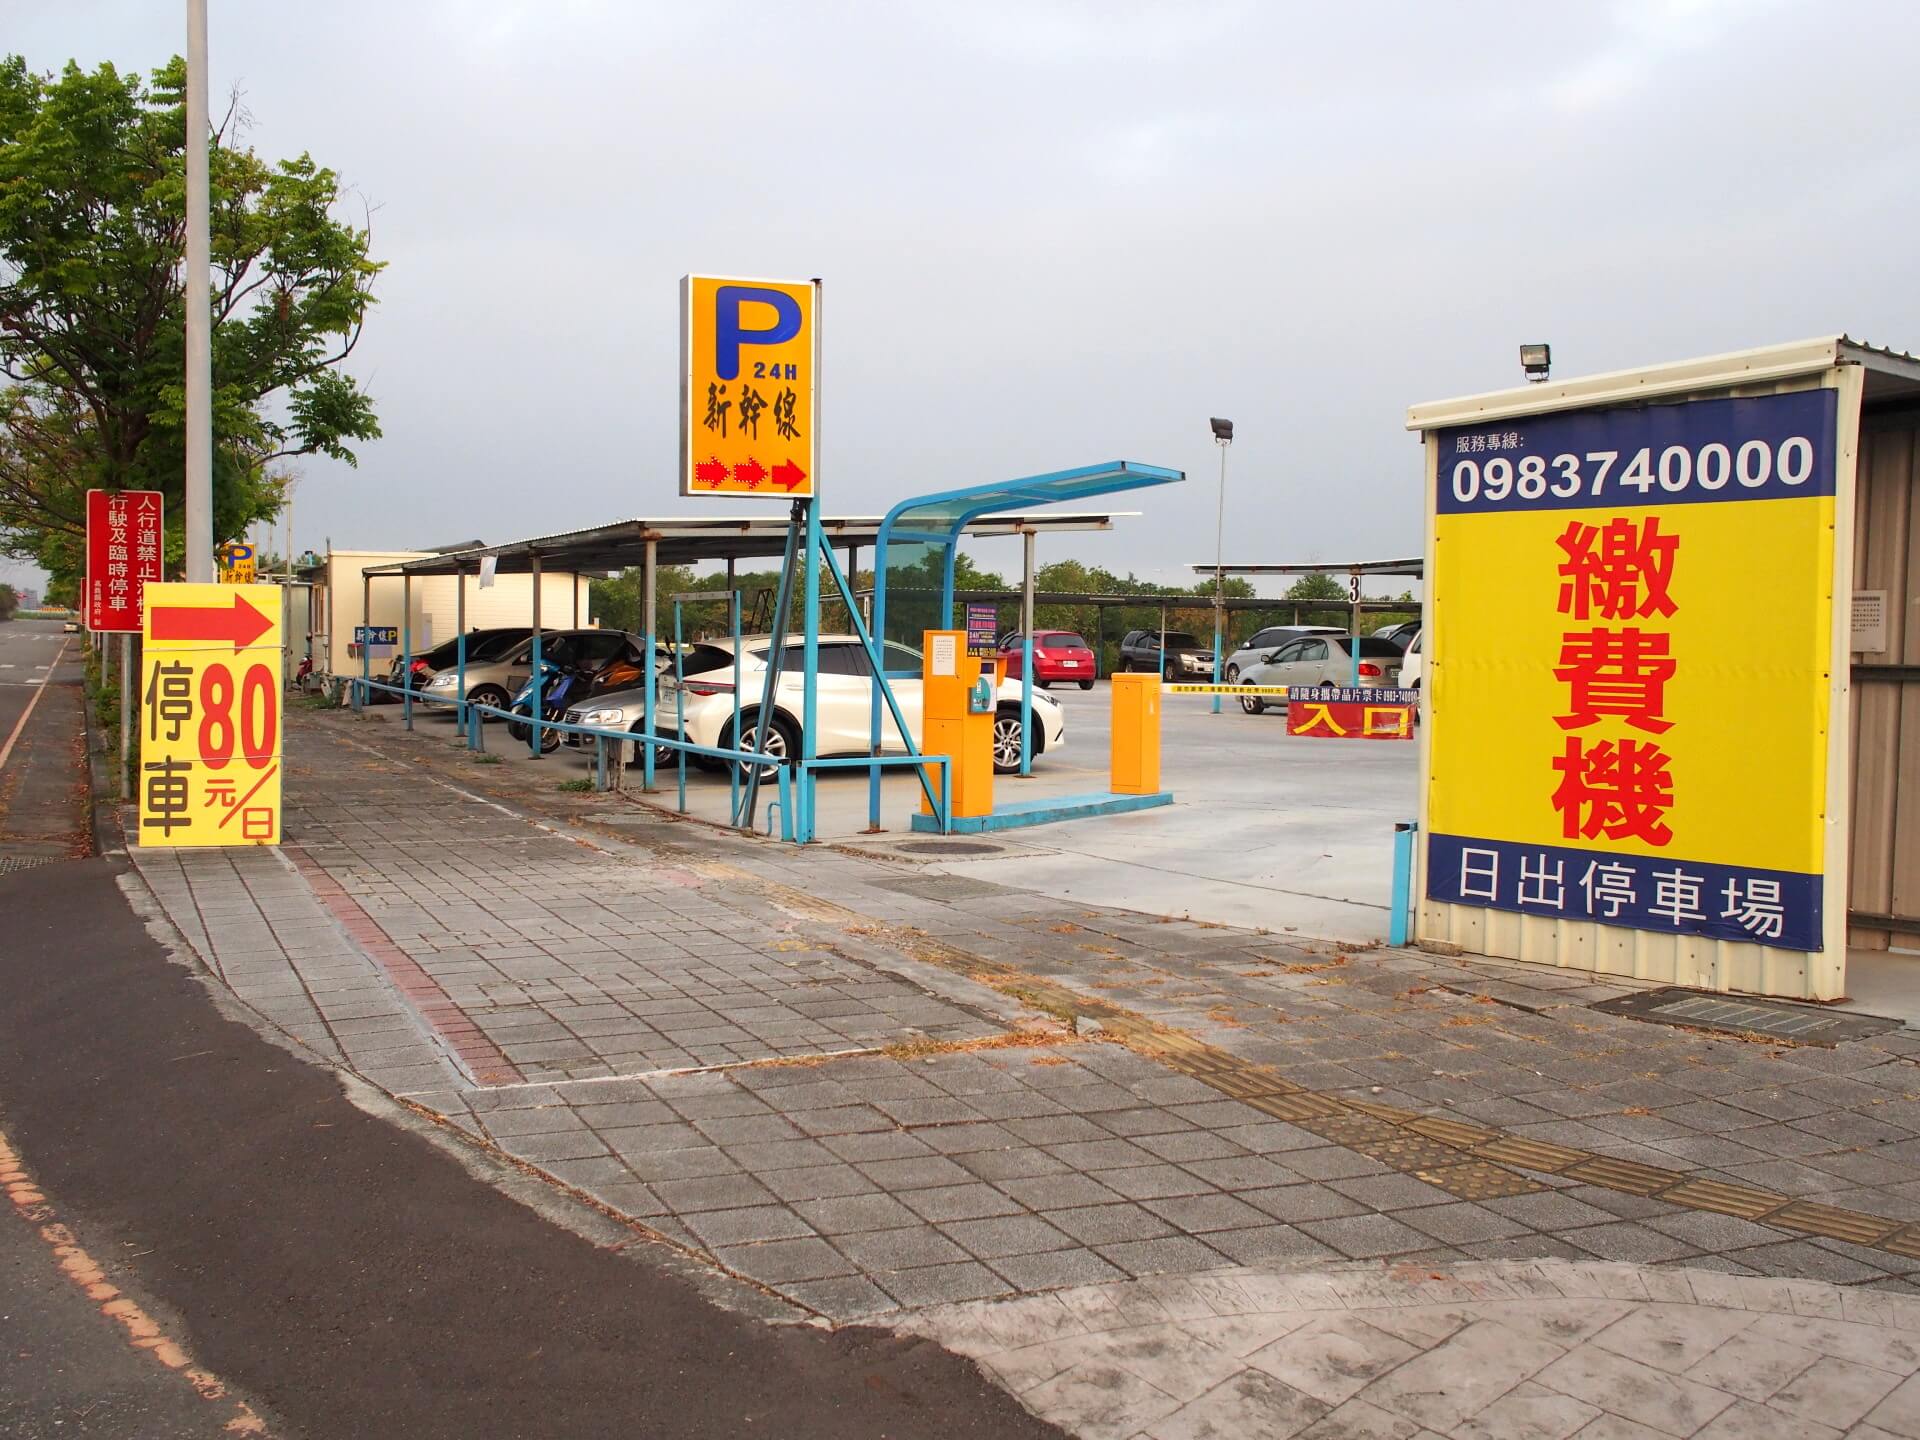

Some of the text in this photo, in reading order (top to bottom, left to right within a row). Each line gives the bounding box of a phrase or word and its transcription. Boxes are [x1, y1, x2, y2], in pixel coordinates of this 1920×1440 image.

[716, 286, 802, 381] P
[754, 362, 797, 380] 24H
[703, 382, 801, 442] 新幹線
[1455, 432, 1525, 453] 服務專線:
[1452, 436, 1814, 502] 0983740000
[108, 494, 129, 612] 行駛及臨時停車
[228, 546, 253, 568] P
[1349, 576, 1360, 602] 3
[1551, 516, 1680, 847] 繳費機
[143, 660, 194, 838] 停車
[198, 663, 277, 770] 80
[1292, 703, 1409, 736] 入口
[1459, 846, 1784, 939] 日出停車場
